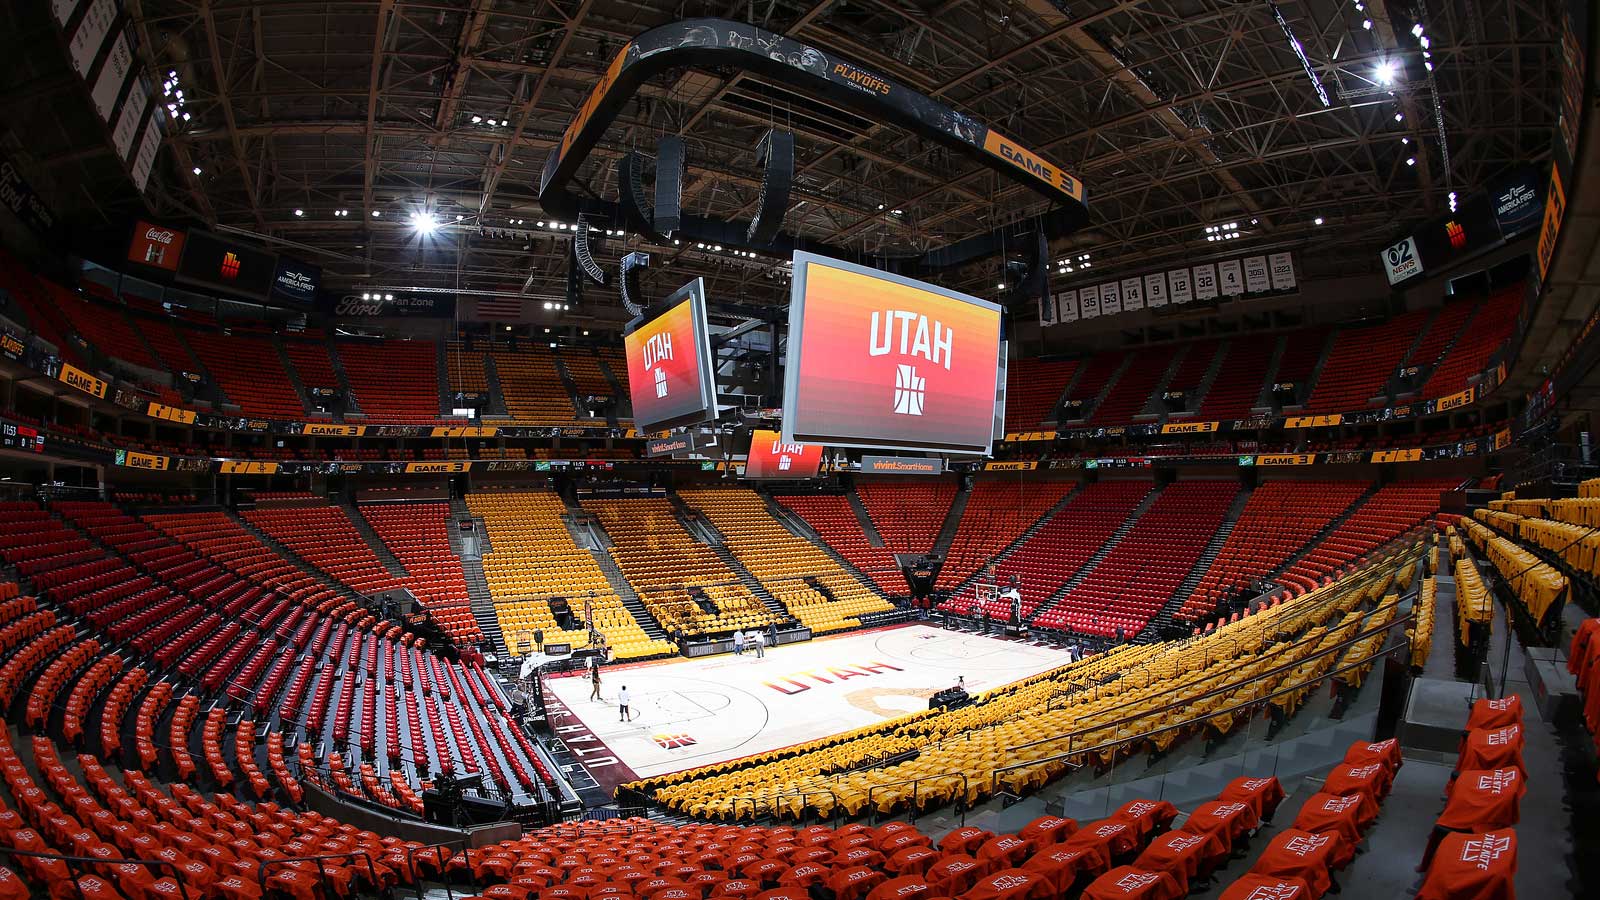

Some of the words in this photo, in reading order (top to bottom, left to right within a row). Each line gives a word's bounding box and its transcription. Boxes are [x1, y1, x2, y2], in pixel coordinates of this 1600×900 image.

[833, 63, 891, 95] PLAYOFFS
[1000, 142, 1052, 184] GAME
[1060, 171, 1075, 194] 3
[1497, 198, 1520, 215] AMERICA
[1520, 189, 1535, 204] FIRST
[1392, 259, 1415, 275] NEWS
[277, 275, 300, 288] AMERICA
[300, 282, 315, 291] FIRST
[1198, 276, 1213, 288] 32
[1227, 272, 1236, 283] 4
[1153, 285, 1160, 295] 9
[1174, 281, 1186, 292] 12
[1104, 293, 1117, 304] 53
[1127, 288, 1138, 300] 14
[336, 295, 385, 317] Ford
[391, 297, 409, 306] Fan
[410, 297, 434, 307] Zone
[1066, 302, 1071, 312] 1
[1083, 297, 1096, 308] 35
[868, 310, 953, 371] UTAH
[643, 331, 673, 371] UTAH
[67, 371, 92, 391] GAME
[95, 378, 103, 395] 3
[1441, 398, 1462, 410] GAME
[1464, 391, 1472, 402] 3
[311, 427, 343, 435] GAME
[347, 427, 358, 435] 3
[1168, 425, 1198, 433] GAME
[1202, 423, 1213, 431] 3
[772, 440, 805, 456] UTAH
[131, 456, 153, 468] GAME
[155, 457, 164, 469] 3
[873, 460, 934, 471] vivint.SmartHome
[1023, 462, 1032, 470] 3
[1263, 457, 1293, 465] GAME
[1298, 456, 1308, 464] 3
[414, 464, 448, 472] GAME
[452, 463, 464, 472] 3
[760, 660, 904, 695] UTAH
[556, 723, 620, 769] UTAH
